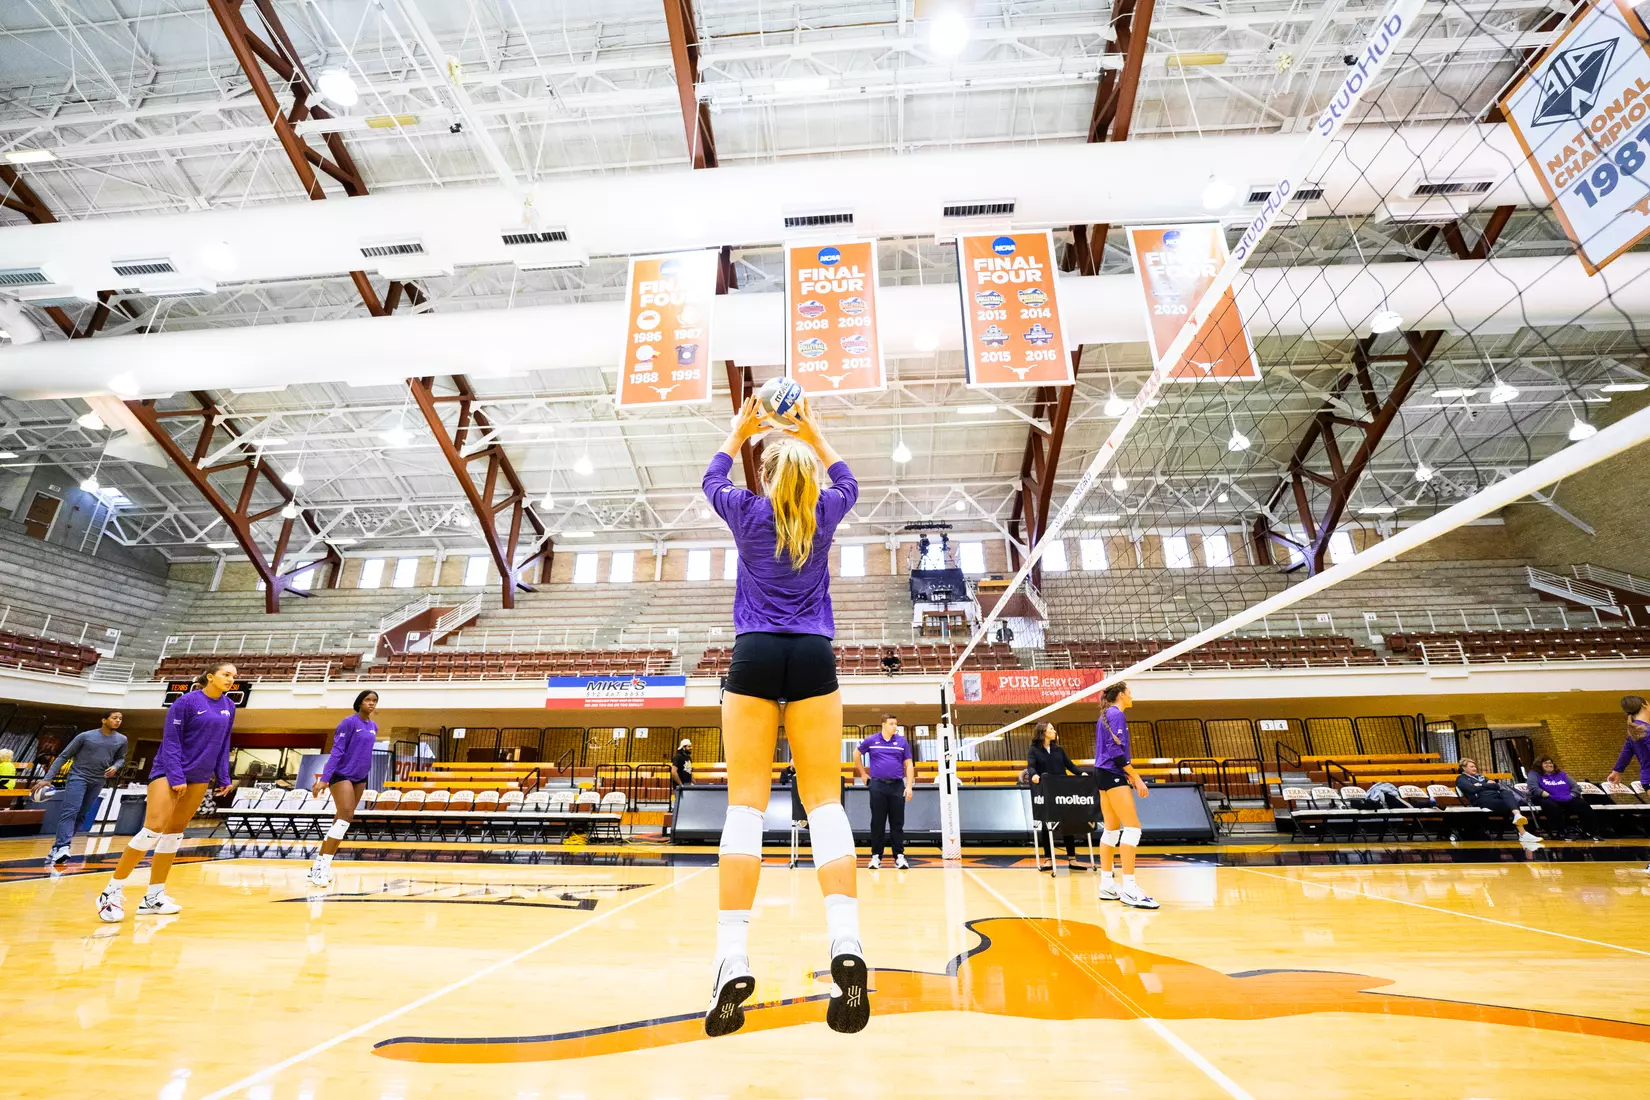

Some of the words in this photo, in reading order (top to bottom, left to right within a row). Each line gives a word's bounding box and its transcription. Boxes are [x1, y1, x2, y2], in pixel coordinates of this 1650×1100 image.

[1318, 13, 1402, 137] StubHub
[1546, 77, 1650, 175] NATIONAL
[1234, 179, 1291, 261] StubHub
[994, 244, 1016, 252] NCAA
[819, 254, 841, 262] NCAA
[973, 255, 1044, 272] FINAL
[798, 265, 866, 282] FINAL
[977, 269, 1044, 285] FOUR
[801, 278, 865, 295] FOUR
[976, 309, 1008, 321] 2013
[1020, 307, 1052, 319] 2014
[1154, 303, 1188, 315] 2020
[795, 318, 829, 332] 2008
[837, 316, 872, 328] 2009
[980, 350, 1012, 363] 2015
[1025, 349, 1057, 362] 2016
[797, 359, 829, 373] 2010
[841, 357, 872, 370] 2012
[629, 371, 659, 385] 1988
[670, 369, 701, 382] 1995
[586, 680, 647, 691] MIKE'S
[998, 675, 1041, 689] PURE
[1041, 678, 1067, 688] JERKY
[1055, 795, 1094, 805] molten
